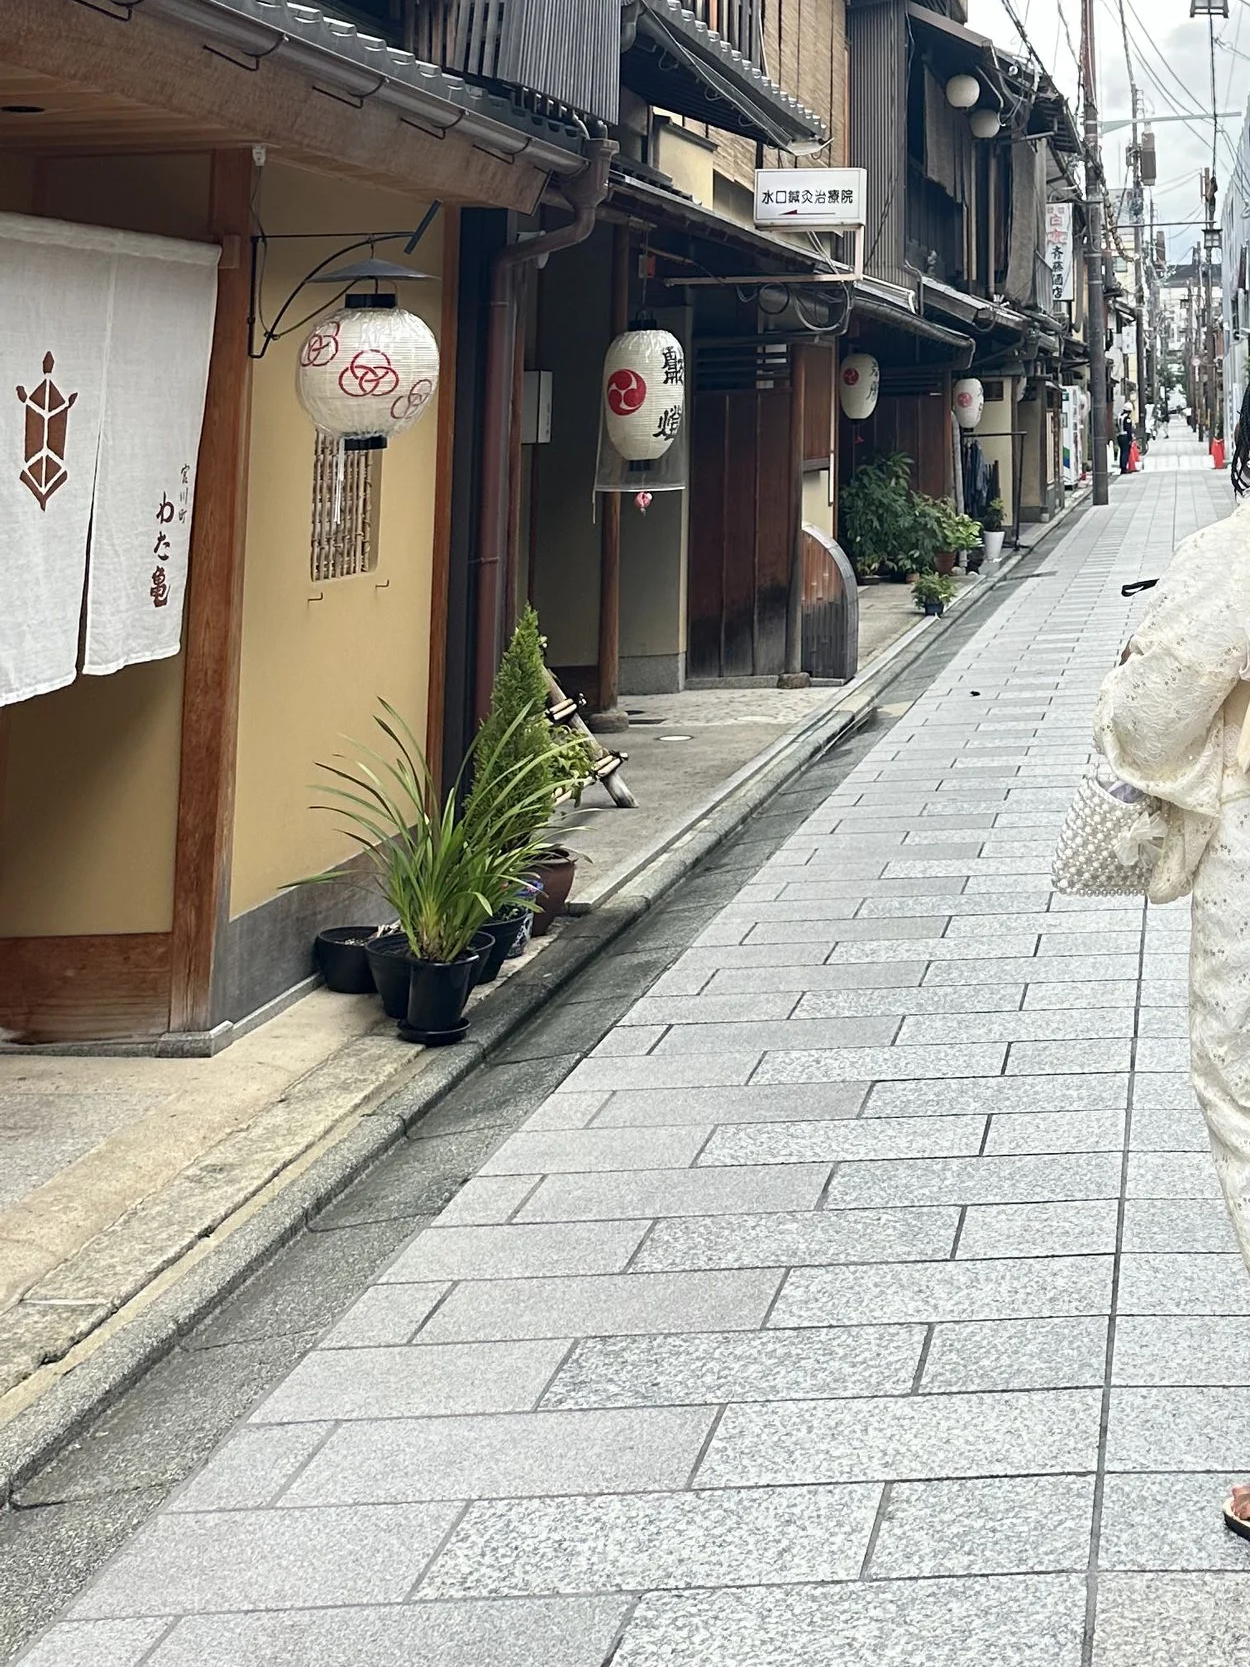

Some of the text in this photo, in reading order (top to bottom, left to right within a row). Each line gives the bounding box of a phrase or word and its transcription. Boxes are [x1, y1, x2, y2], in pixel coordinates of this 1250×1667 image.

[761, 189, 853, 205] 水口鍼灸治療院
[149, 491, 175, 608] わた亀
